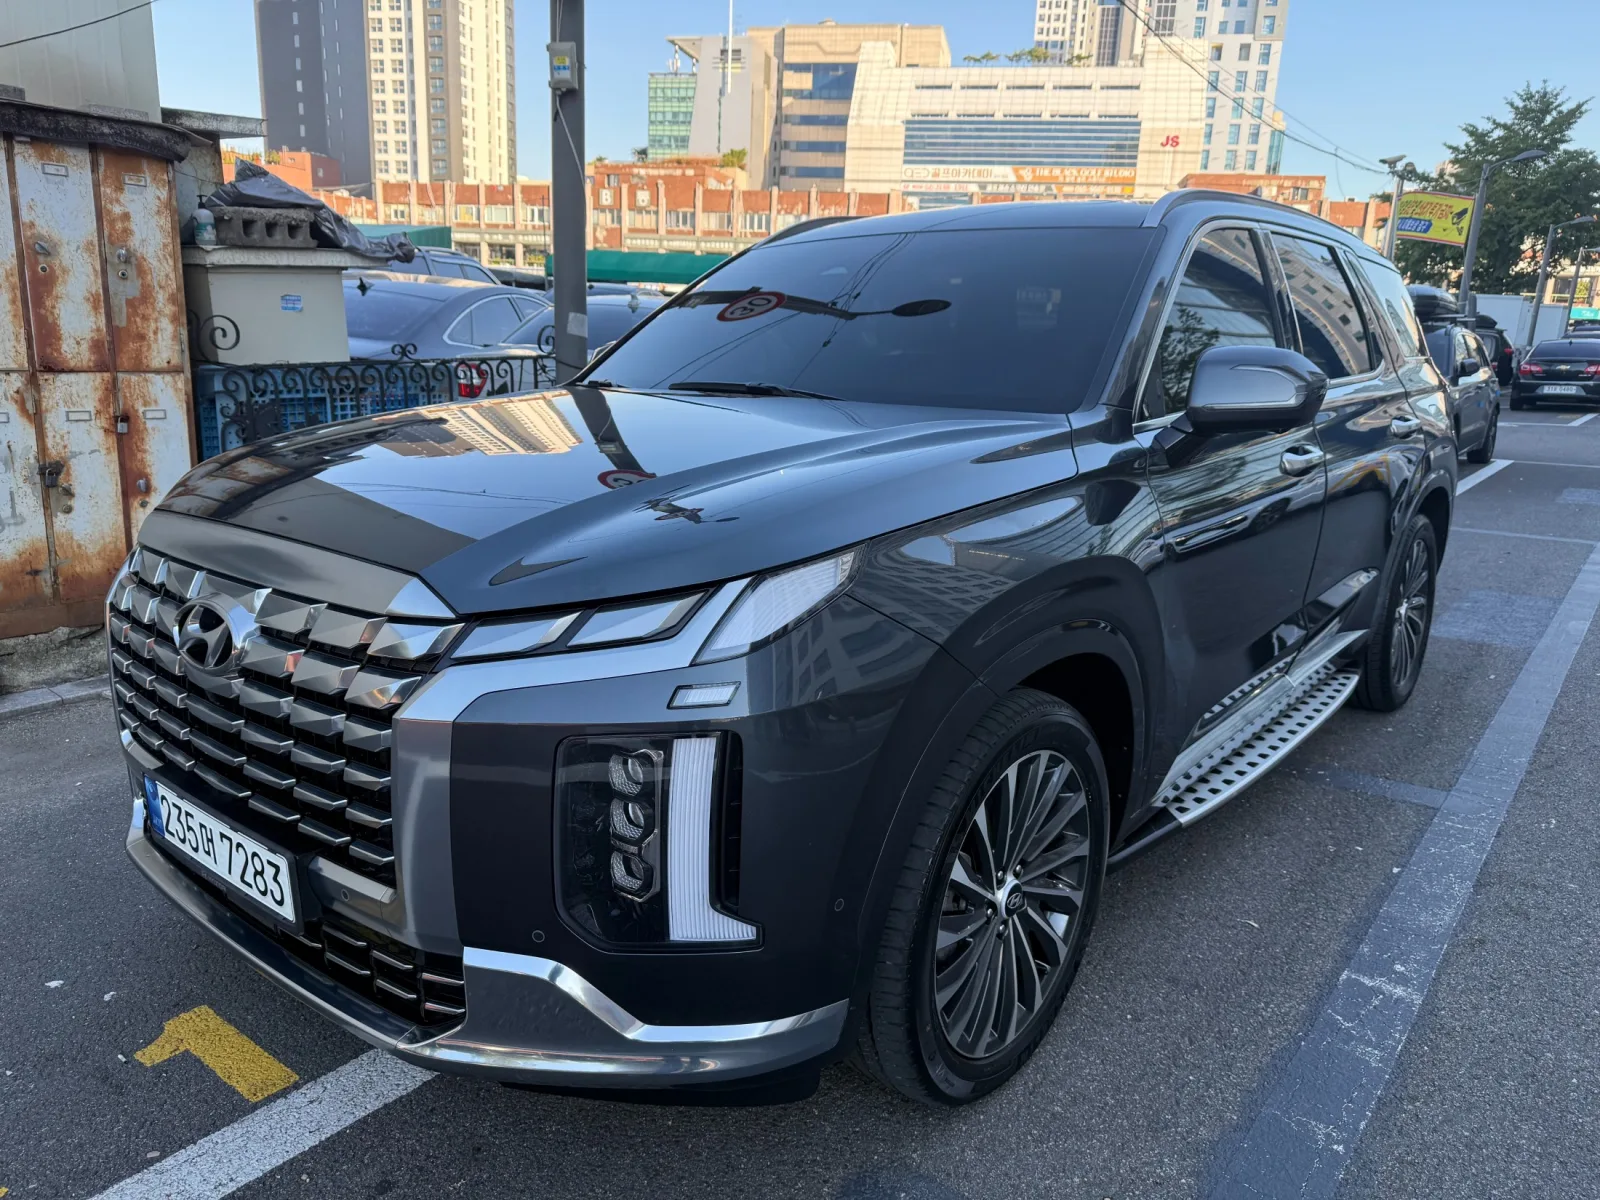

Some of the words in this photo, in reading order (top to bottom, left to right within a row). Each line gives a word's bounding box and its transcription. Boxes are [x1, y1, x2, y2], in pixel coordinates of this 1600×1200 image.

[1160, 135, 1180, 148] JS
[601, 189, 611, 204] B
[160, 795, 218, 866] 235머
[219, 831, 285, 907] 7283
